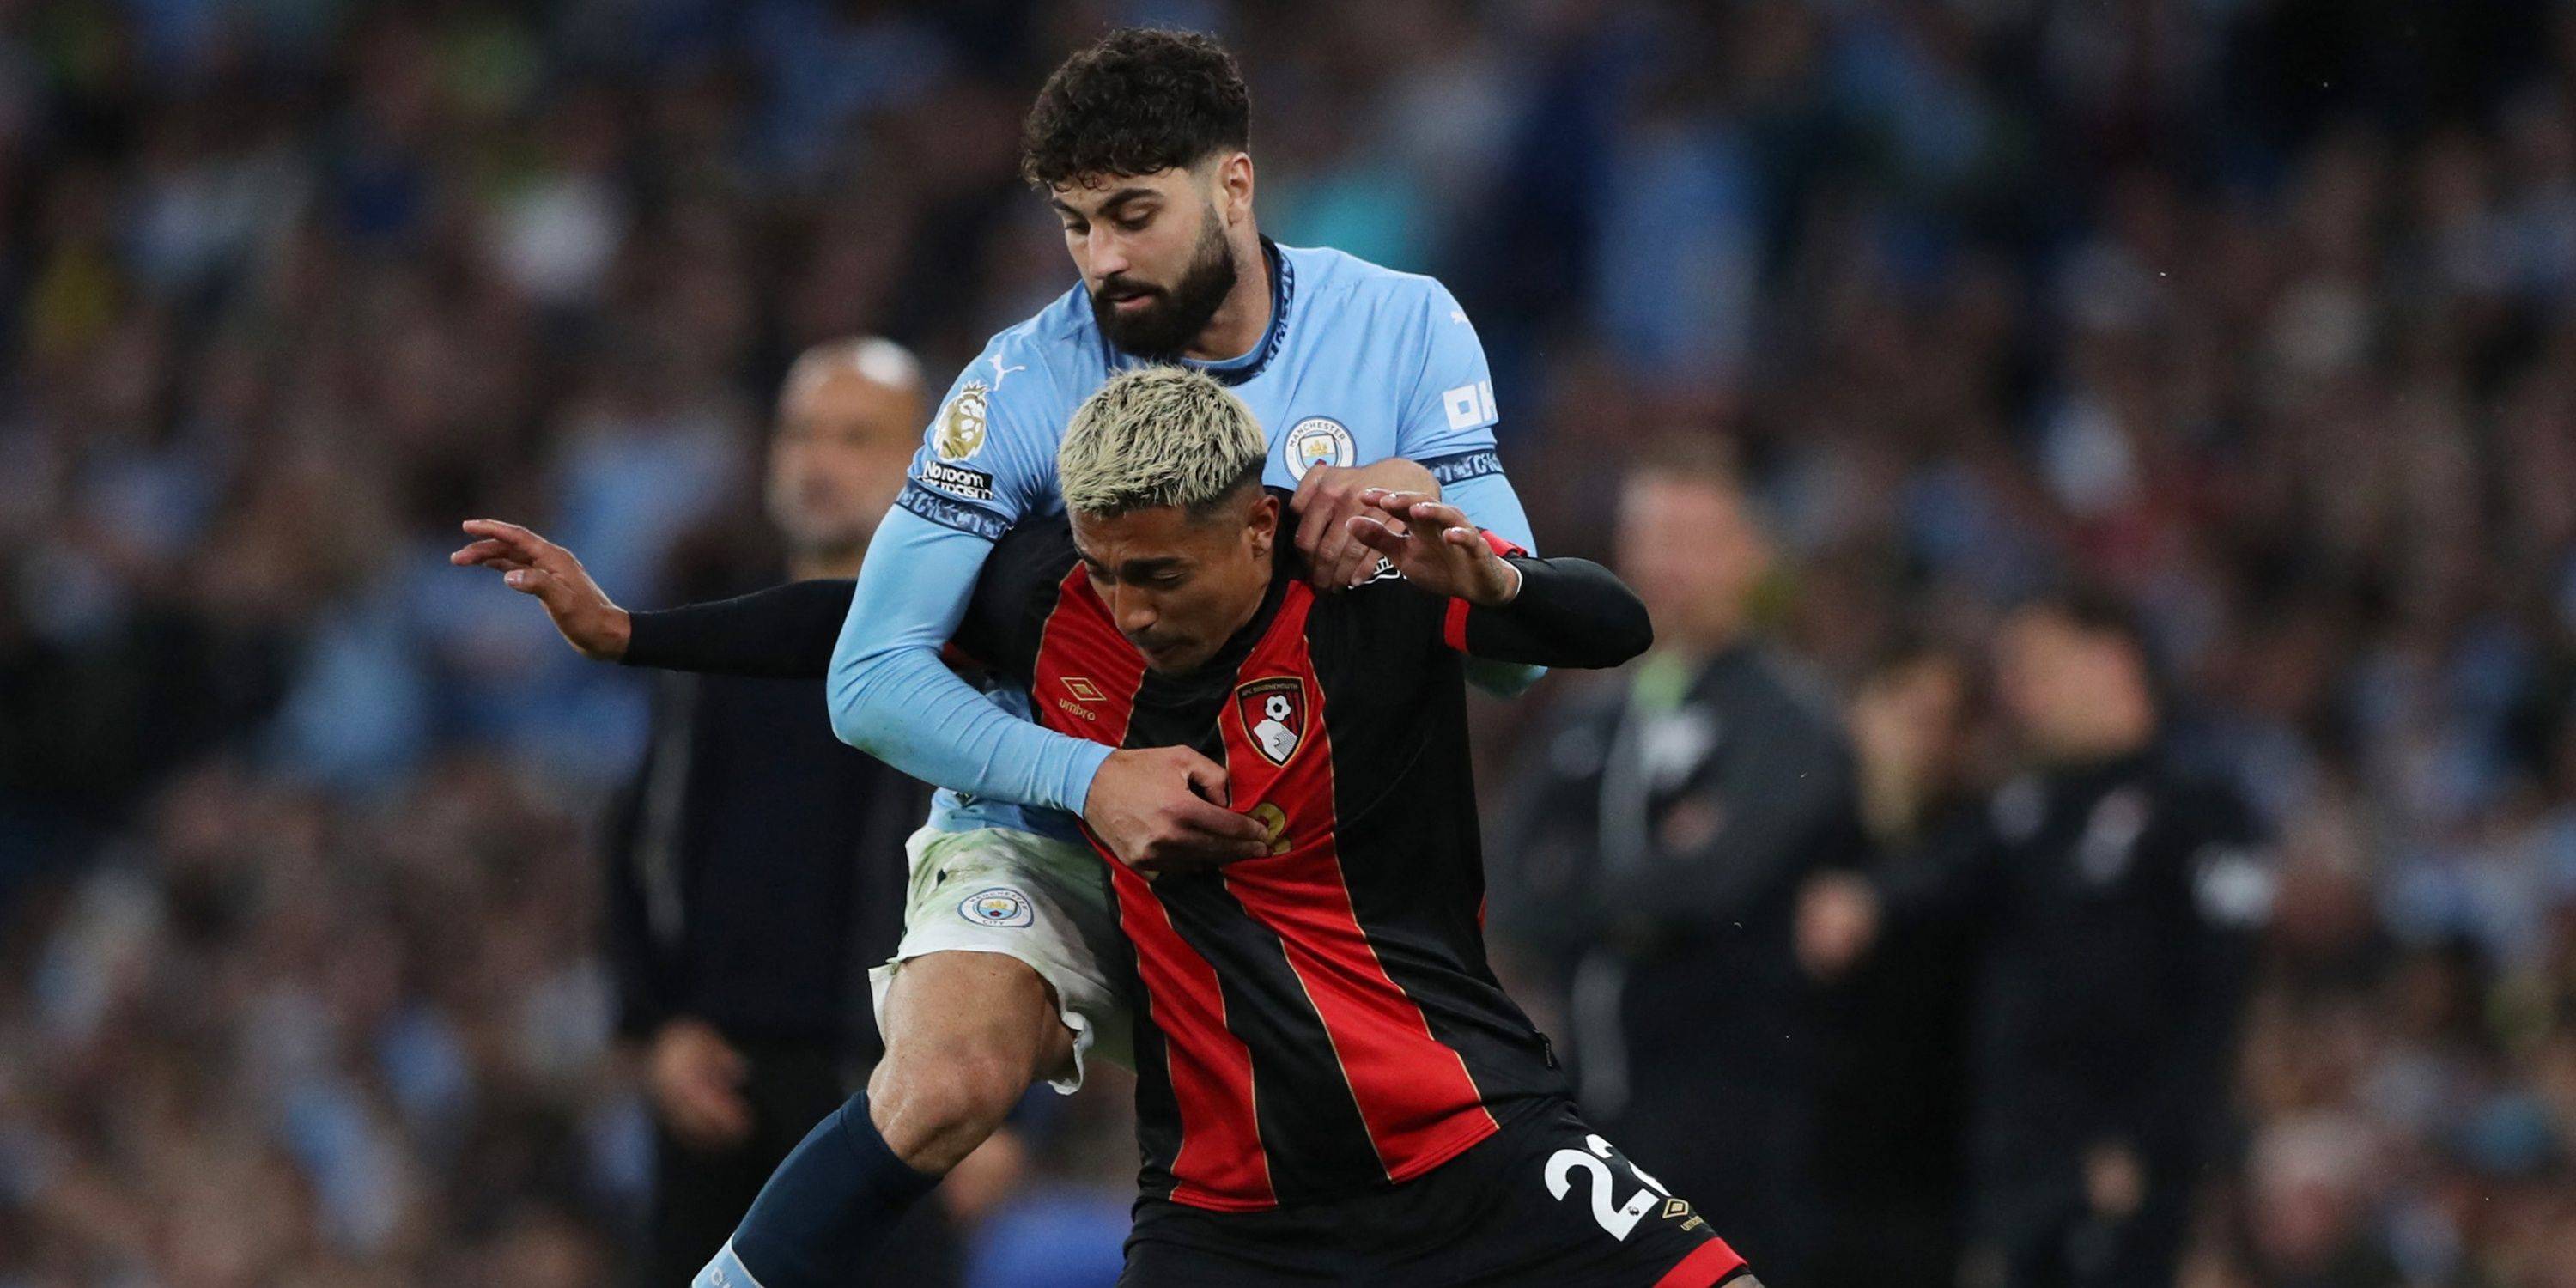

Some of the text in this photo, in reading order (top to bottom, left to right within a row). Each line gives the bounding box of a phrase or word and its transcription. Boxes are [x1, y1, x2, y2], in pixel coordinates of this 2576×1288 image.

[1289, 421, 1346, 447] MANCHESTER
[921, 460, 984, 488] No room
[1059, 697, 1096, 721] umbro
